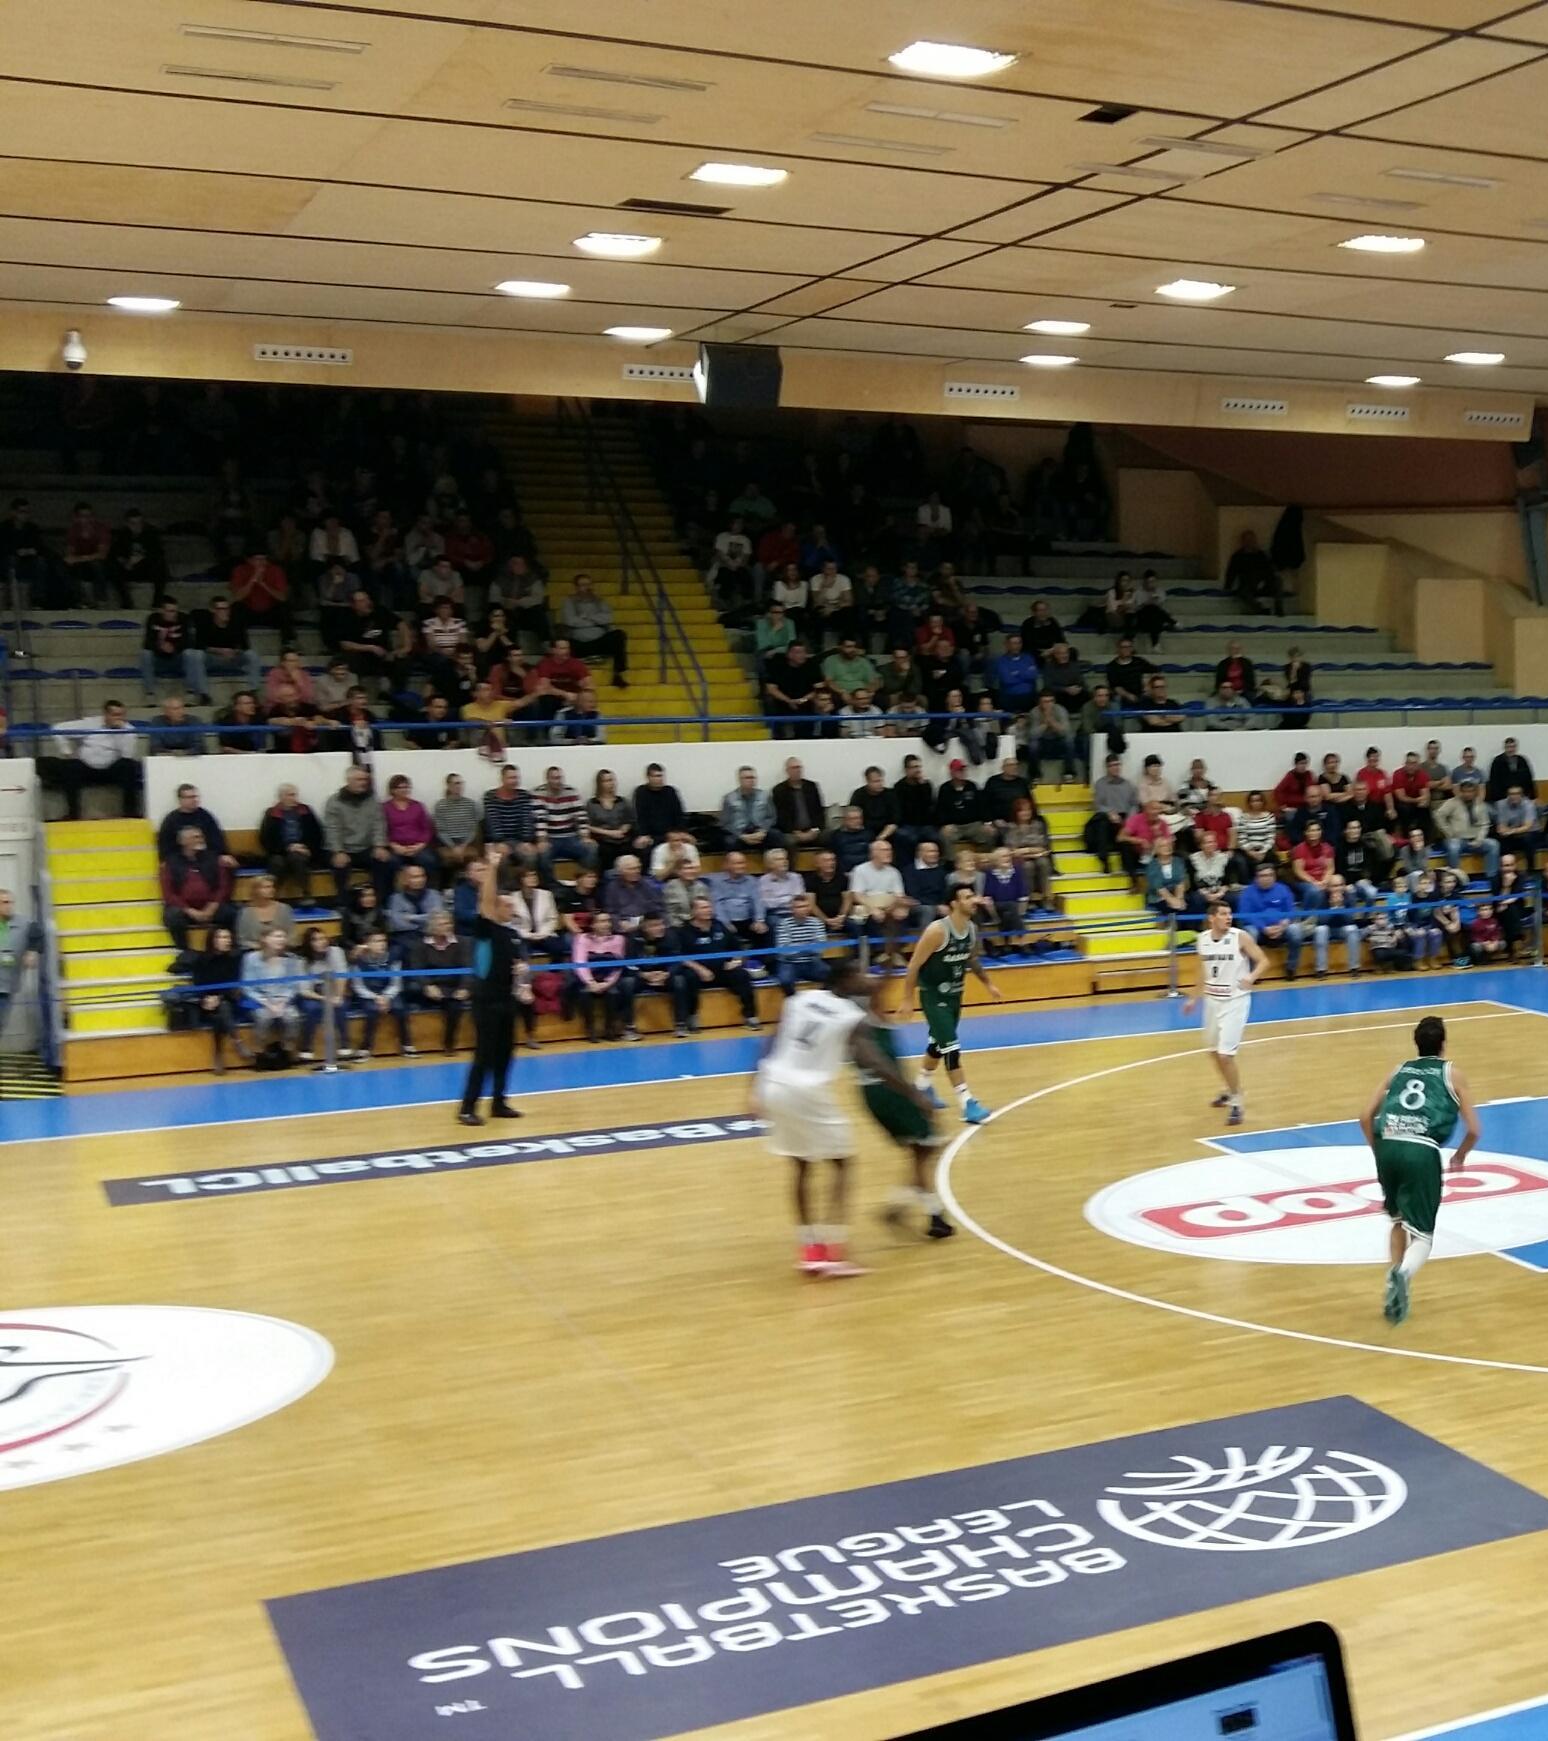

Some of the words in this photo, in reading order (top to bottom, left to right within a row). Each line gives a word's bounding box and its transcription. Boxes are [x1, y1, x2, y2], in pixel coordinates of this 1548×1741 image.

[1399, 1079, 1426, 1111] 8
[716, 1500, 1065, 1583] LEAGUE
[407, 1523, 1095, 1683] CHAMPIONS
[510, 1547, 1128, 1689] BASKETBALL
